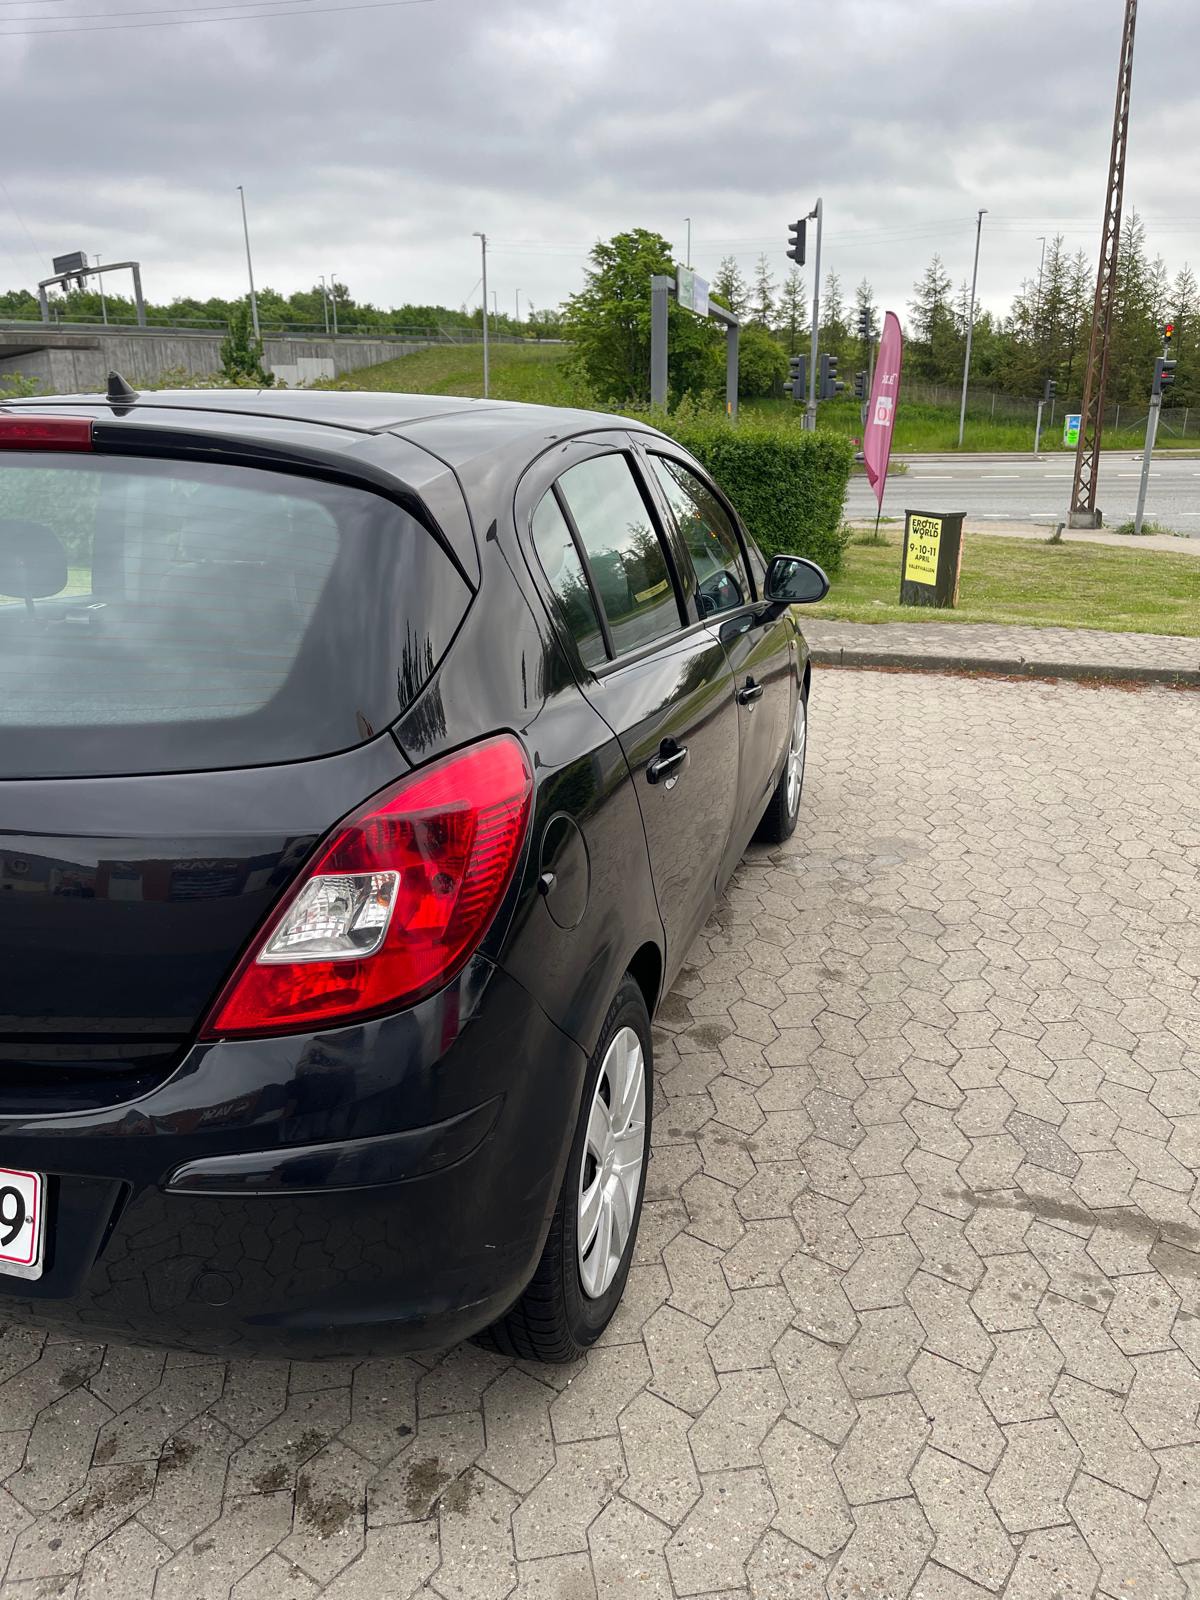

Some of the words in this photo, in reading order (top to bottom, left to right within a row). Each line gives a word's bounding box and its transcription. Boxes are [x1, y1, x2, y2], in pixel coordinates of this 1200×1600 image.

[912, 519, 939, 530] EROTIC
[912, 526, 939, 538] WORLD
[915, 554, 930, 563] APRIL
[0, 1186, 26, 1246] 9
